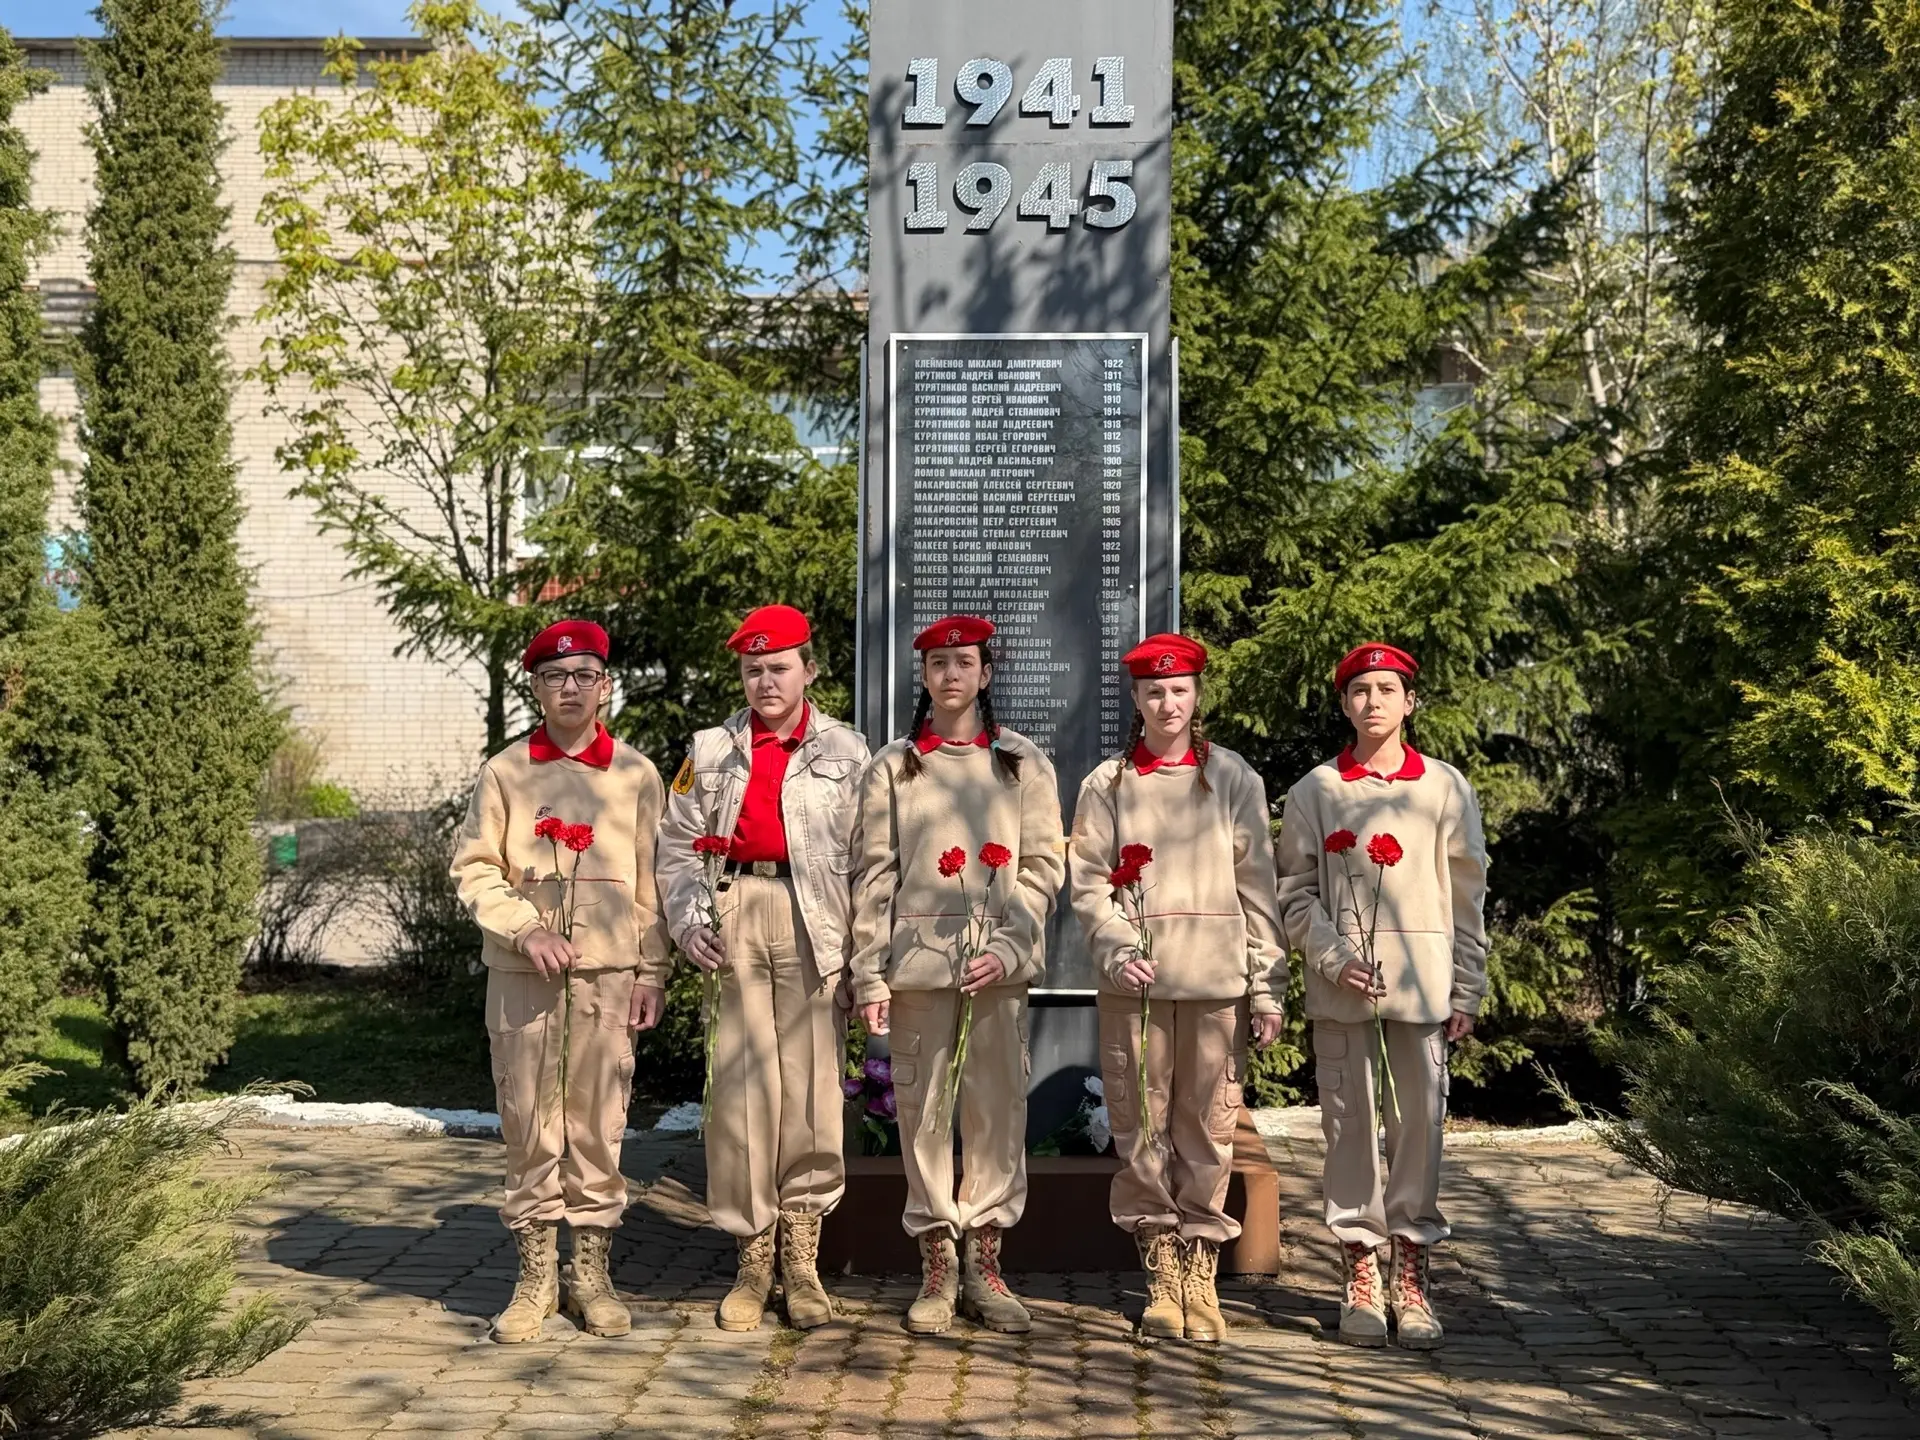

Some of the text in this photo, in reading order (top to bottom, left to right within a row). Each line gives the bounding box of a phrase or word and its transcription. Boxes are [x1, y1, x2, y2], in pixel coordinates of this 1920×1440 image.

[903, 56, 1135, 126] 1941
[903, 160, 1137, 230] 1945
[915, 358, 1123, 369] КЛЕЙМЕНОВ МИХАИЛ ДМИТРИЕВИЧ 1922
[915, 370, 1121, 381] КРУТИКОВ АНДРЕЙ ИВАНОВИЧ 1911
[915, 382, 967, 391] КУРЯТНИКОВ
[972, 381, 1009, 391] ВАСИЛИЙ
[1014, 382, 1061, 392] АНДРЕЕВИЧ
[915, 393, 1121, 403] КУРЯТНИКОВ СЕРГЕЙ ИВАНОВИЧ 1910
[915, 406, 1121, 417] КУРЯТНИКОВ АНДРЕЙ СТЕПАНОВИЧ 1914
[915, 419, 970, 428] КУРЯТНИКОВ
[975, 419, 998, 428] ИВАН
[1003, 419, 1053, 429] АНДРЕЕВИЧ
[915, 431, 1121, 440] КУРЯТНИКОВ ИВАН ЕГОРОВИЧ 1912
[915, 443, 1121, 453] КУРЯТНИКОВ СЕРГЕЙ ЕГОРОВИЧ 1915
[915, 456, 953, 465] ЛОГИНОВ
[959, 455, 993, 466] АНДРЕЙ
[997, 456, 1053, 465] ВАСИЛЬЕВИЧ
[915, 468, 945, 477] ЛОМОВ
[949, 468, 986, 477] МИХАИЛ
[991, 468, 1035, 477] ПЕТРОВИЧ
[914, 479, 978, 489] МАКАРОВСКИЙ
[984, 479, 1021, 489] АЛЕКСЕЙ
[1026, 480, 1074, 489] СЕРГЕЕВИЧ
[914, 491, 1120, 501] МАКАРОВСКИЙ ВАСИЛИЙ СЕРГЕЕВИЧ 1915
[914, 503, 978, 513] МАКАРОВСКИЙ
[983, 504, 1005, 513] ИВАН
[1010, 504, 1058, 513] СЕРГЕЕВИЧ
[914, 516, 1121, 526] МАКАРОВСКИЙ ПЕТР СЕРГЕЕВИЧ 1905
[914, 528, 978, 538] МАКАРОВСКИЙ
[983, 529, 1015, 538] СТЕПАН
[1020, 529, 1067, 538] СЕРГЕЕВИЧ
[914, 541, 1120, 550] МАКЕЕВ БОРИС ИВАНОВИЧ 1922
[914, 552, 1120, 562] МАКЕЕВ ВАСИЛИЙ СЕМЕНОВИЧ 1910
[914, 565, 948, 574] МАКЕЕВ
[953, 564, 992, 574] ВАСИЛИЙ
[998, 565, 1051, 574] АЛЕКСЕЕВИЧ
[914, 577, 1119, 587] МАКЕЕВ ИВАН ДМИТРИЕВИЧ 1911
[914, 589, 948, 598] МАКЕЕВ
[953, 589, 988, 598] МИХАИЛ
[994, 589, 1049, 598] НИКОЛАЕВИЧ
[914, 601, 948, 610] МАКЕЕВ
[953, 600, 992, 610] НИКОЛАЙ
[997, 601, 1044, 610] СЕРГЕЕВИЧ
[991, 626, 1031, 635] ВАНОВИЧ
[1006, 638, 1051, 647] ИВАНОВИЧ
[1005, 650, 1050, 659] ИВАНОВИЧ
[1015, 662, 1070, 671] ВАСИЛЬЕВИЧ
[995, 674, 1050, 683] НИКОЛАЕВИЧ
[994, 686, 1050, 695] НИКОЛАЕВИЧ
[1012, 698, 1067, 707] ВАСИЛЬЕВИЧ
